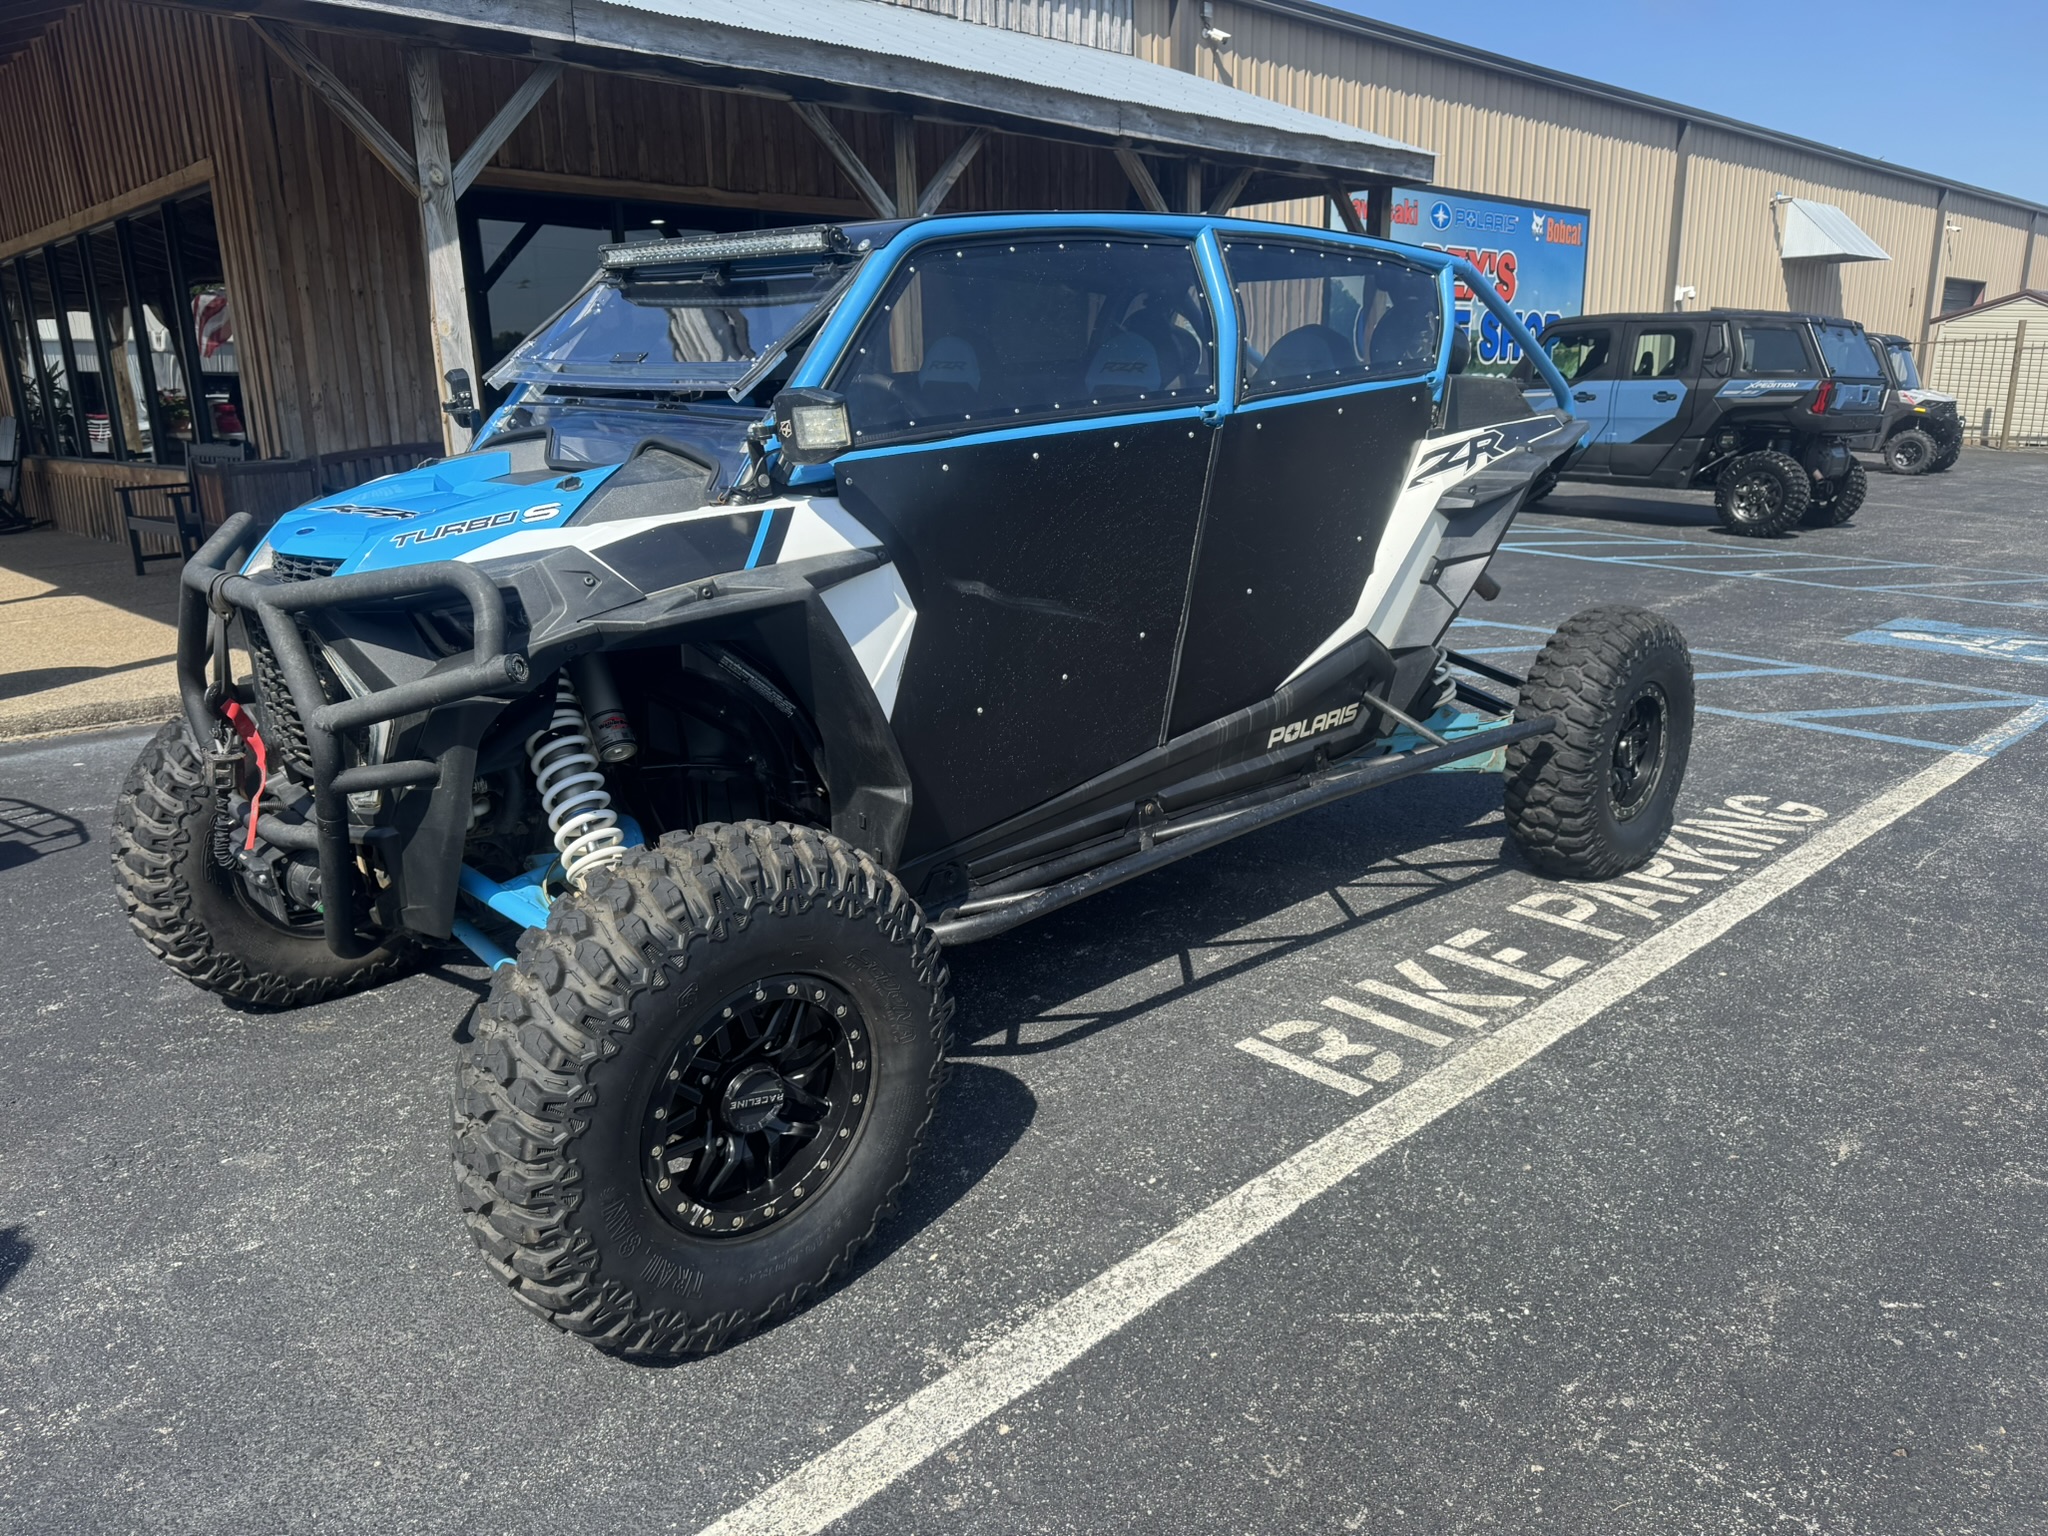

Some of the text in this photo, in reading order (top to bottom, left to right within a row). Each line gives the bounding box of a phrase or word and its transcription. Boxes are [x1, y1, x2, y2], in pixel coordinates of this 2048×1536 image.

[1454, 208, 1518, 234] POLARIS
[1546, 217, 1583, 246] Bobcat
[1744, 380, 1799, 390] XPEDITION
[390, 502, 563, 549] TURBO S
[1267, 702, 1360, 749] POLARIS
[1234, 794, 1829, 1096] BIKE PARKING
[729, 1093, 784, 1110] RACELINE
